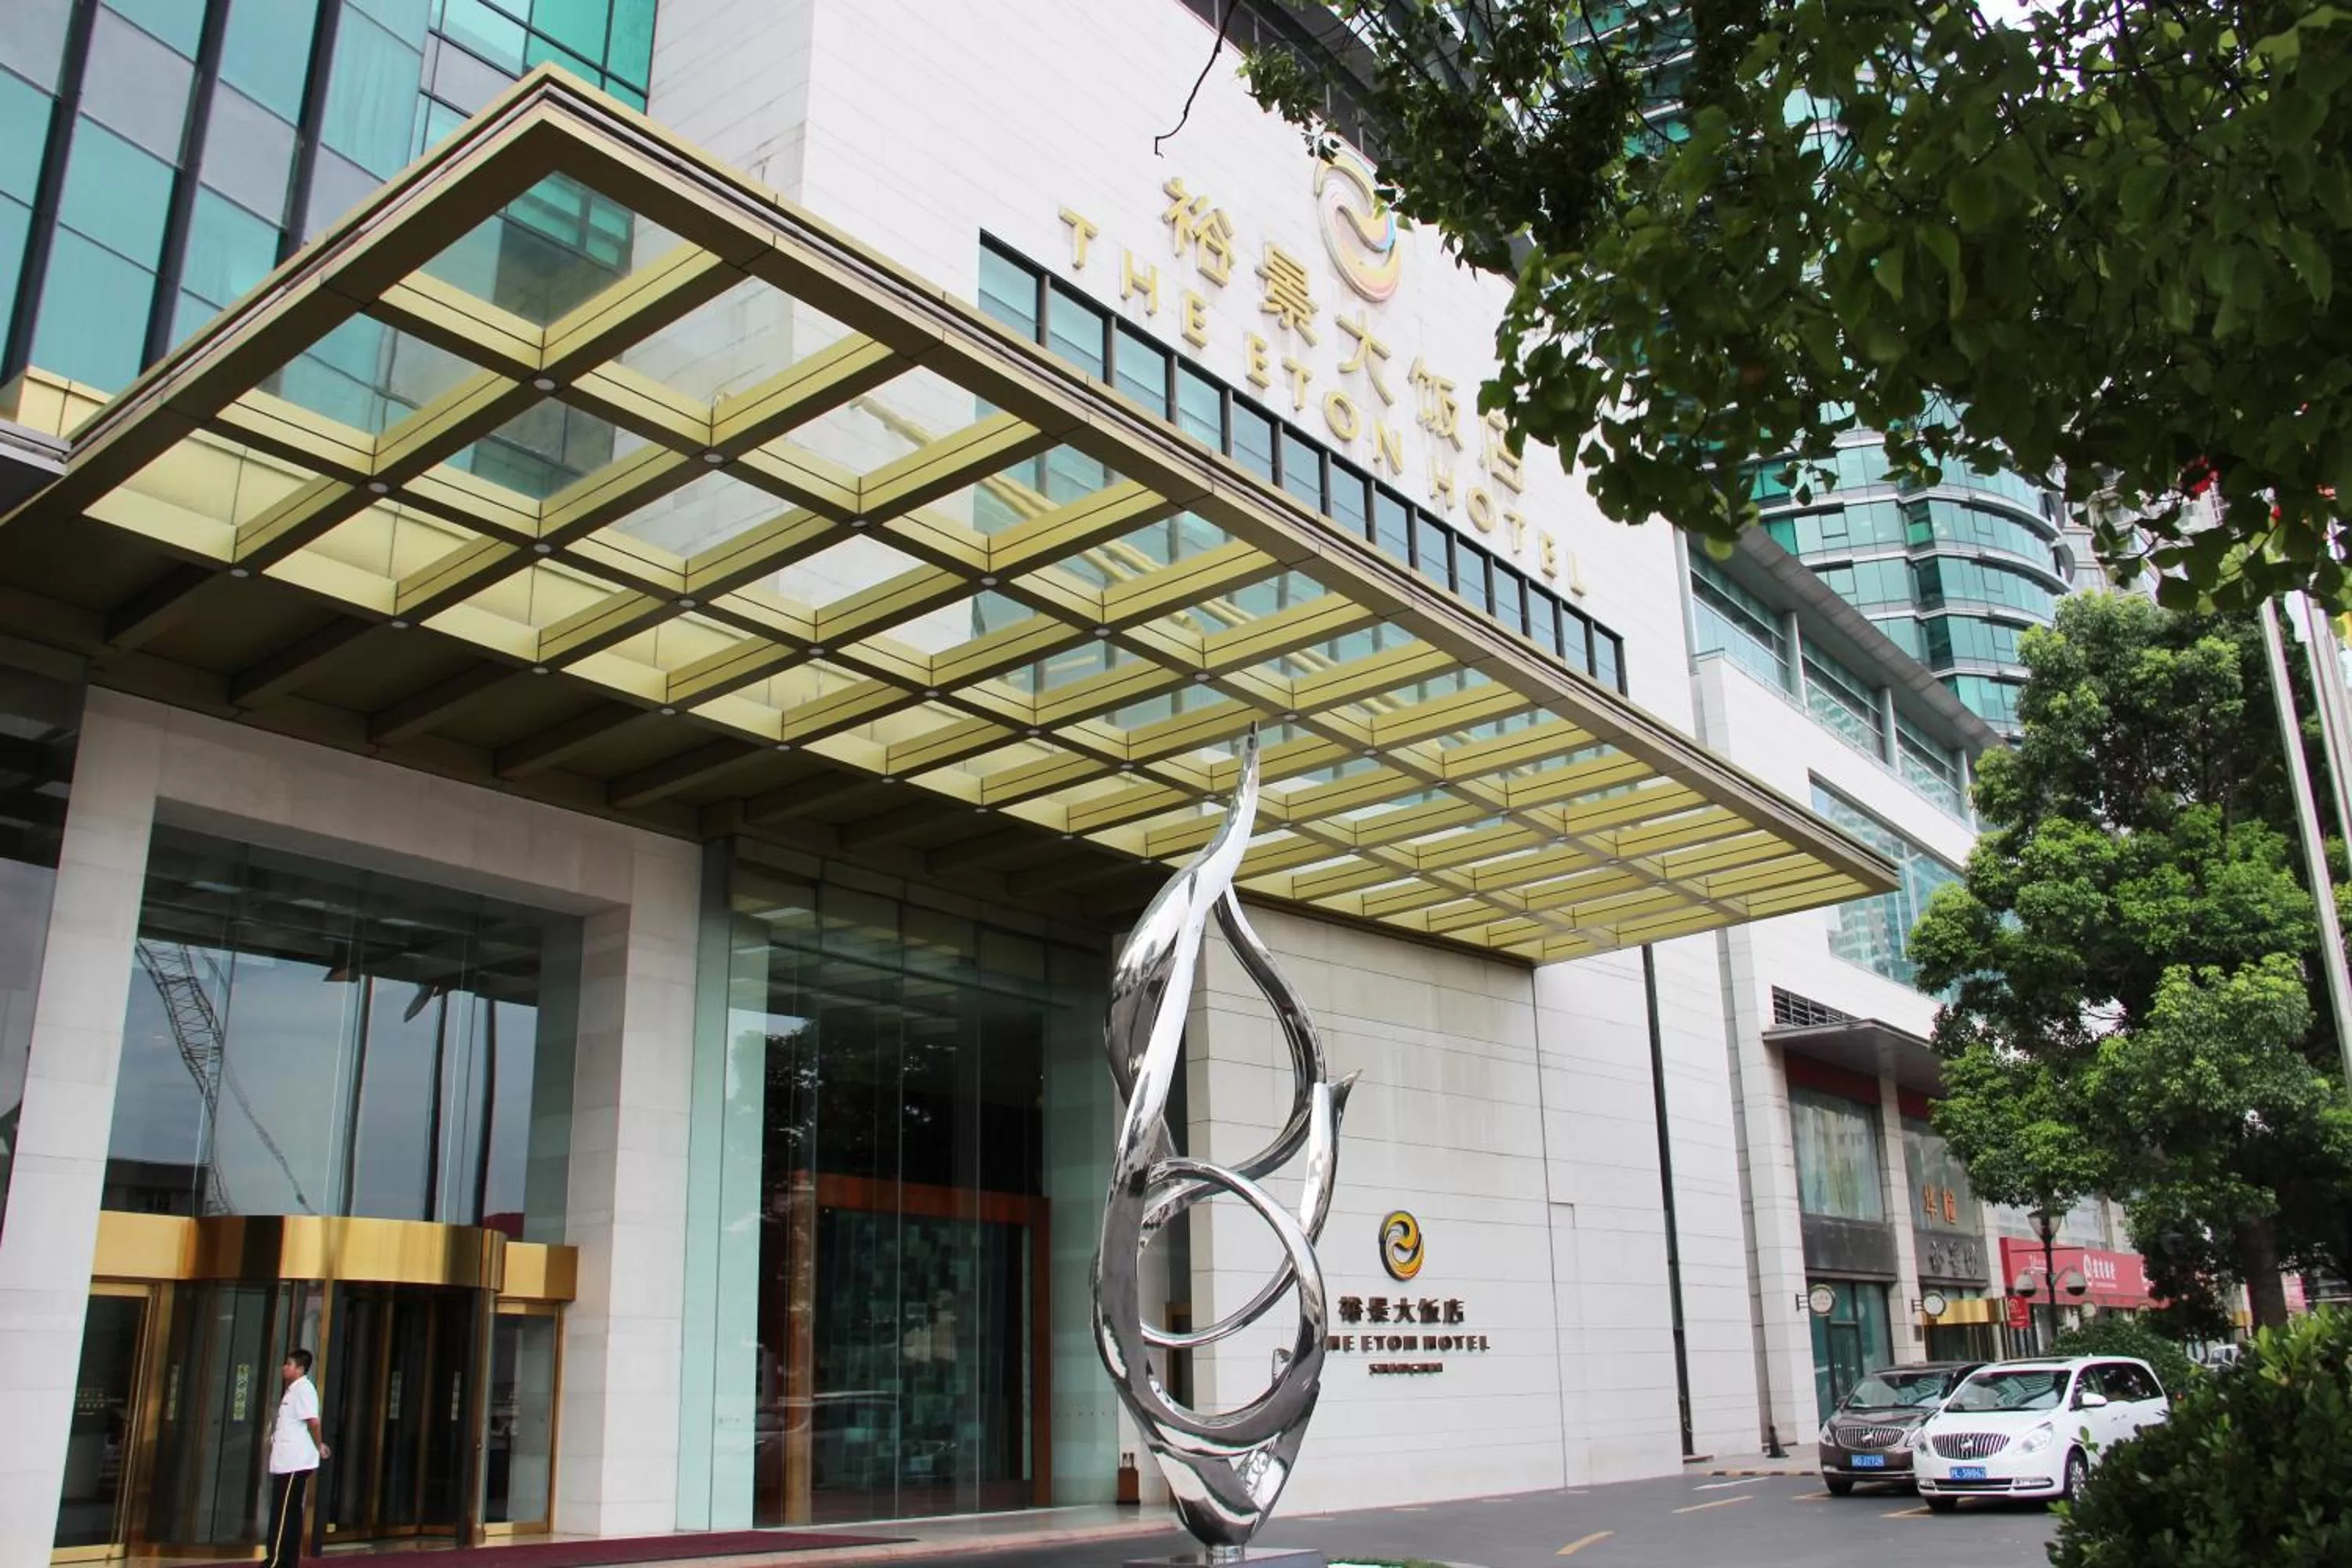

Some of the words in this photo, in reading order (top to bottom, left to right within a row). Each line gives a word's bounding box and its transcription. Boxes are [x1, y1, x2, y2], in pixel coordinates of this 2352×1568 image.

[1058, 205, 1207, 349] THE
[1243, 332, 1403, 476] ETON
[1428, 456, 1585, 597] HOTEL
[1325, 1335, 1356, 1353] HE
[1360, 1335, 1418, 1353] ETON
[1423, 1335, 1490, 1353] HOTEL
